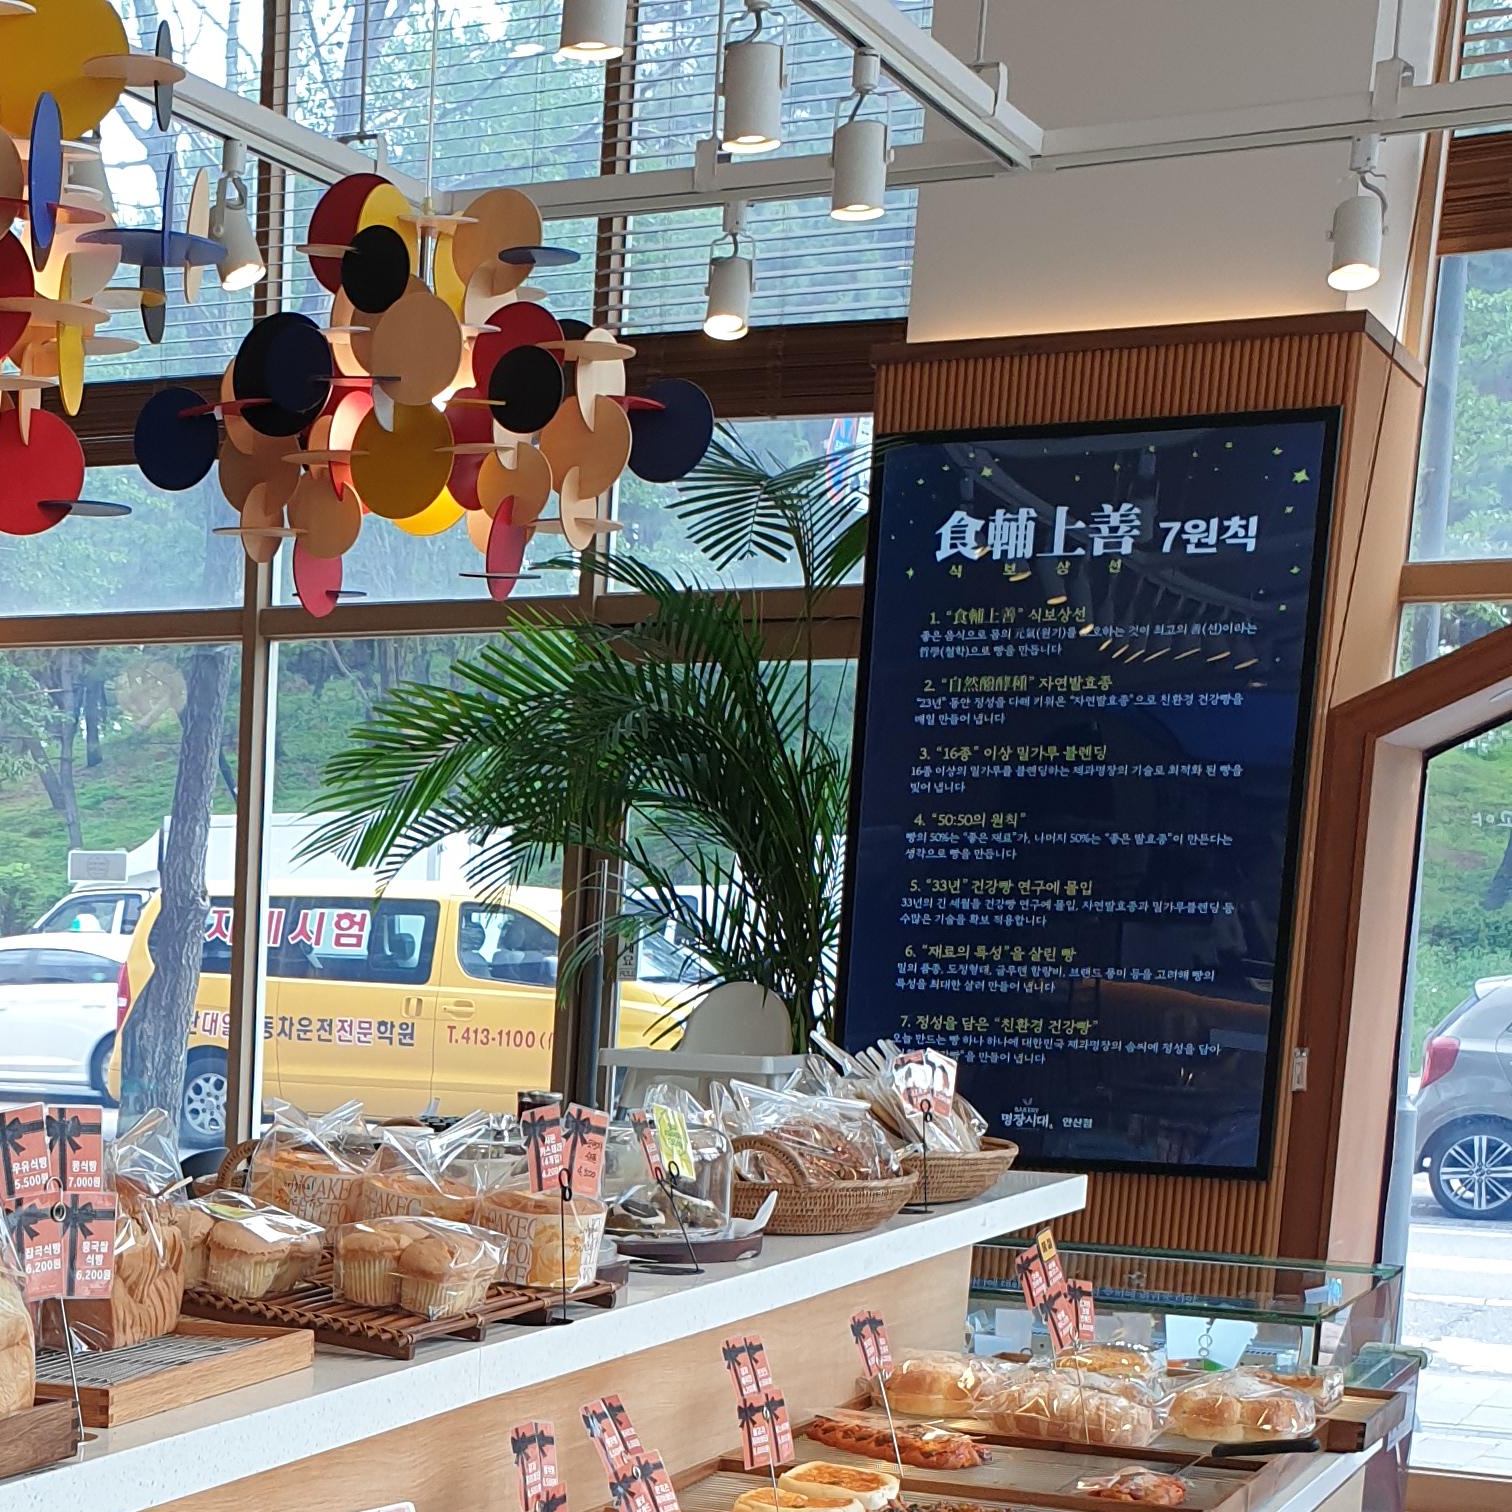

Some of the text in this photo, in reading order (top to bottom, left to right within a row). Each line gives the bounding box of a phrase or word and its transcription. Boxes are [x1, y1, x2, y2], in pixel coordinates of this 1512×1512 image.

[934, 503, 1259, 562] 食輔上善 7원칙
[12, 1156, 47, 1174] 우유식빵
